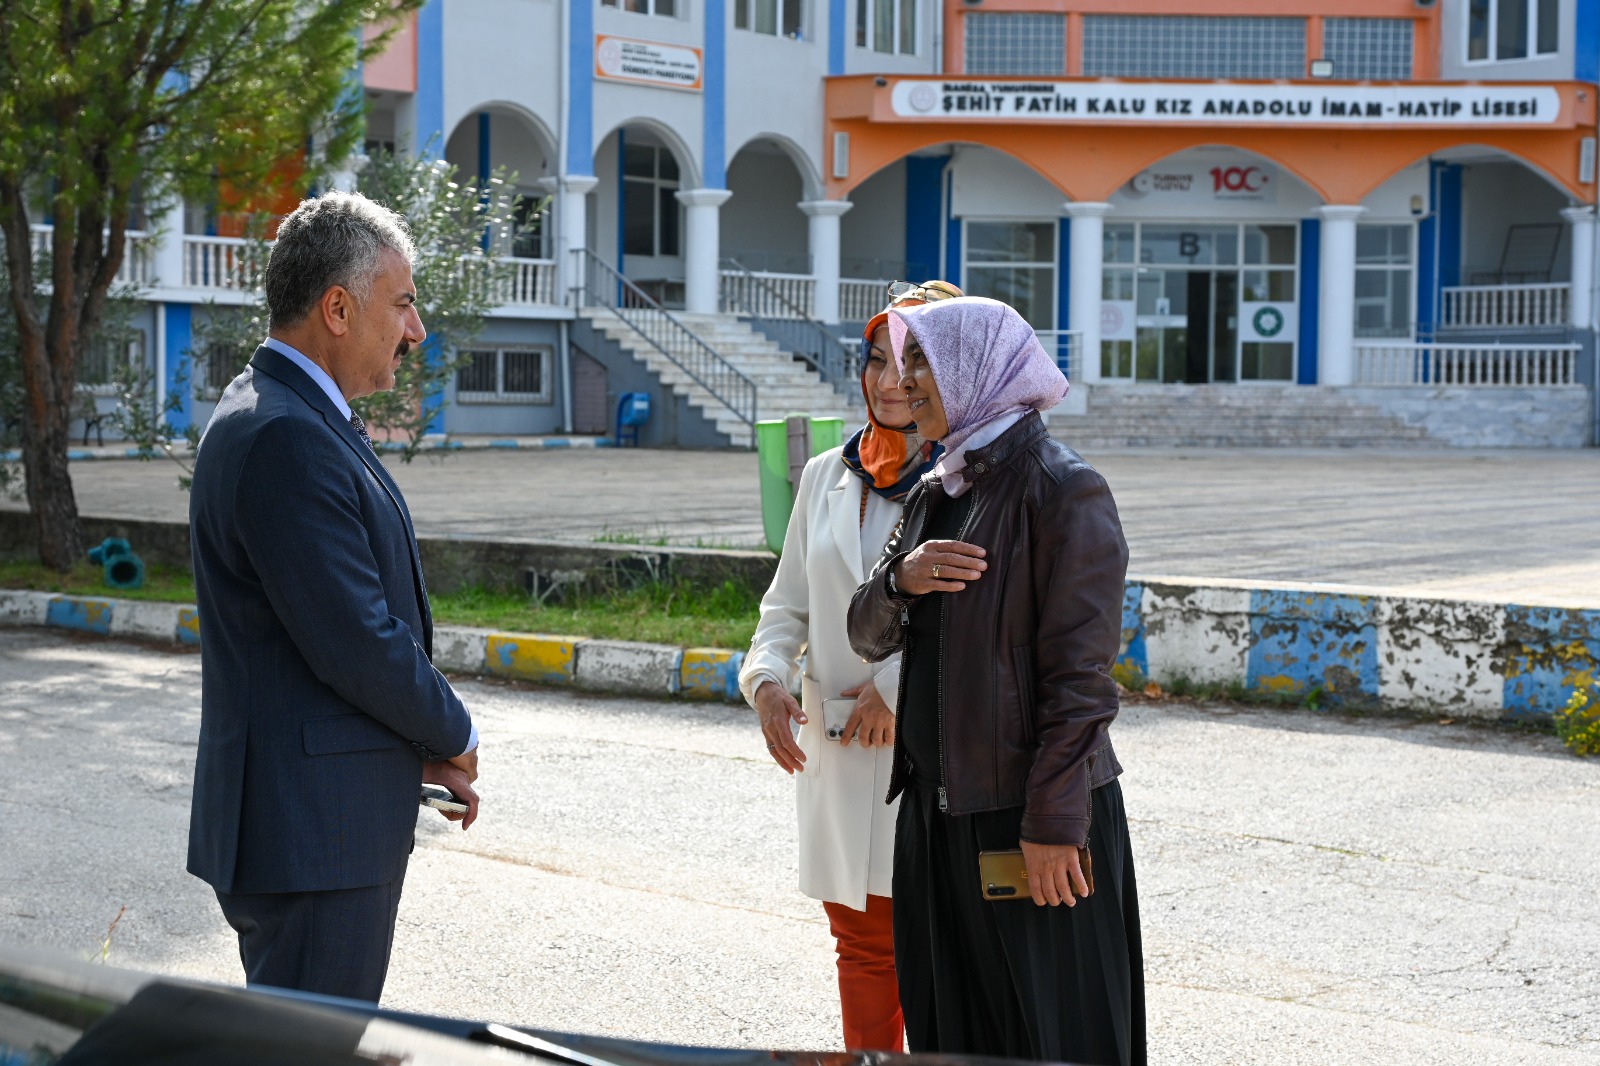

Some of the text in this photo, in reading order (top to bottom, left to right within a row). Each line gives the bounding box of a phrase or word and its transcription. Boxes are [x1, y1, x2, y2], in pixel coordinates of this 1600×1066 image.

[942, 94, 1004, 113] ŞEHİT
[1014, 94, 1077, 113] FATİH
[1086, 98, 1146, 113] KALU
[1156, 99, 1192, 114] KIZ
[1202, 99, 1312, 115] ANADOLU
[1471, 97, 1538, 117] LİSESİ
[1180, 232, 1200, 256] B
